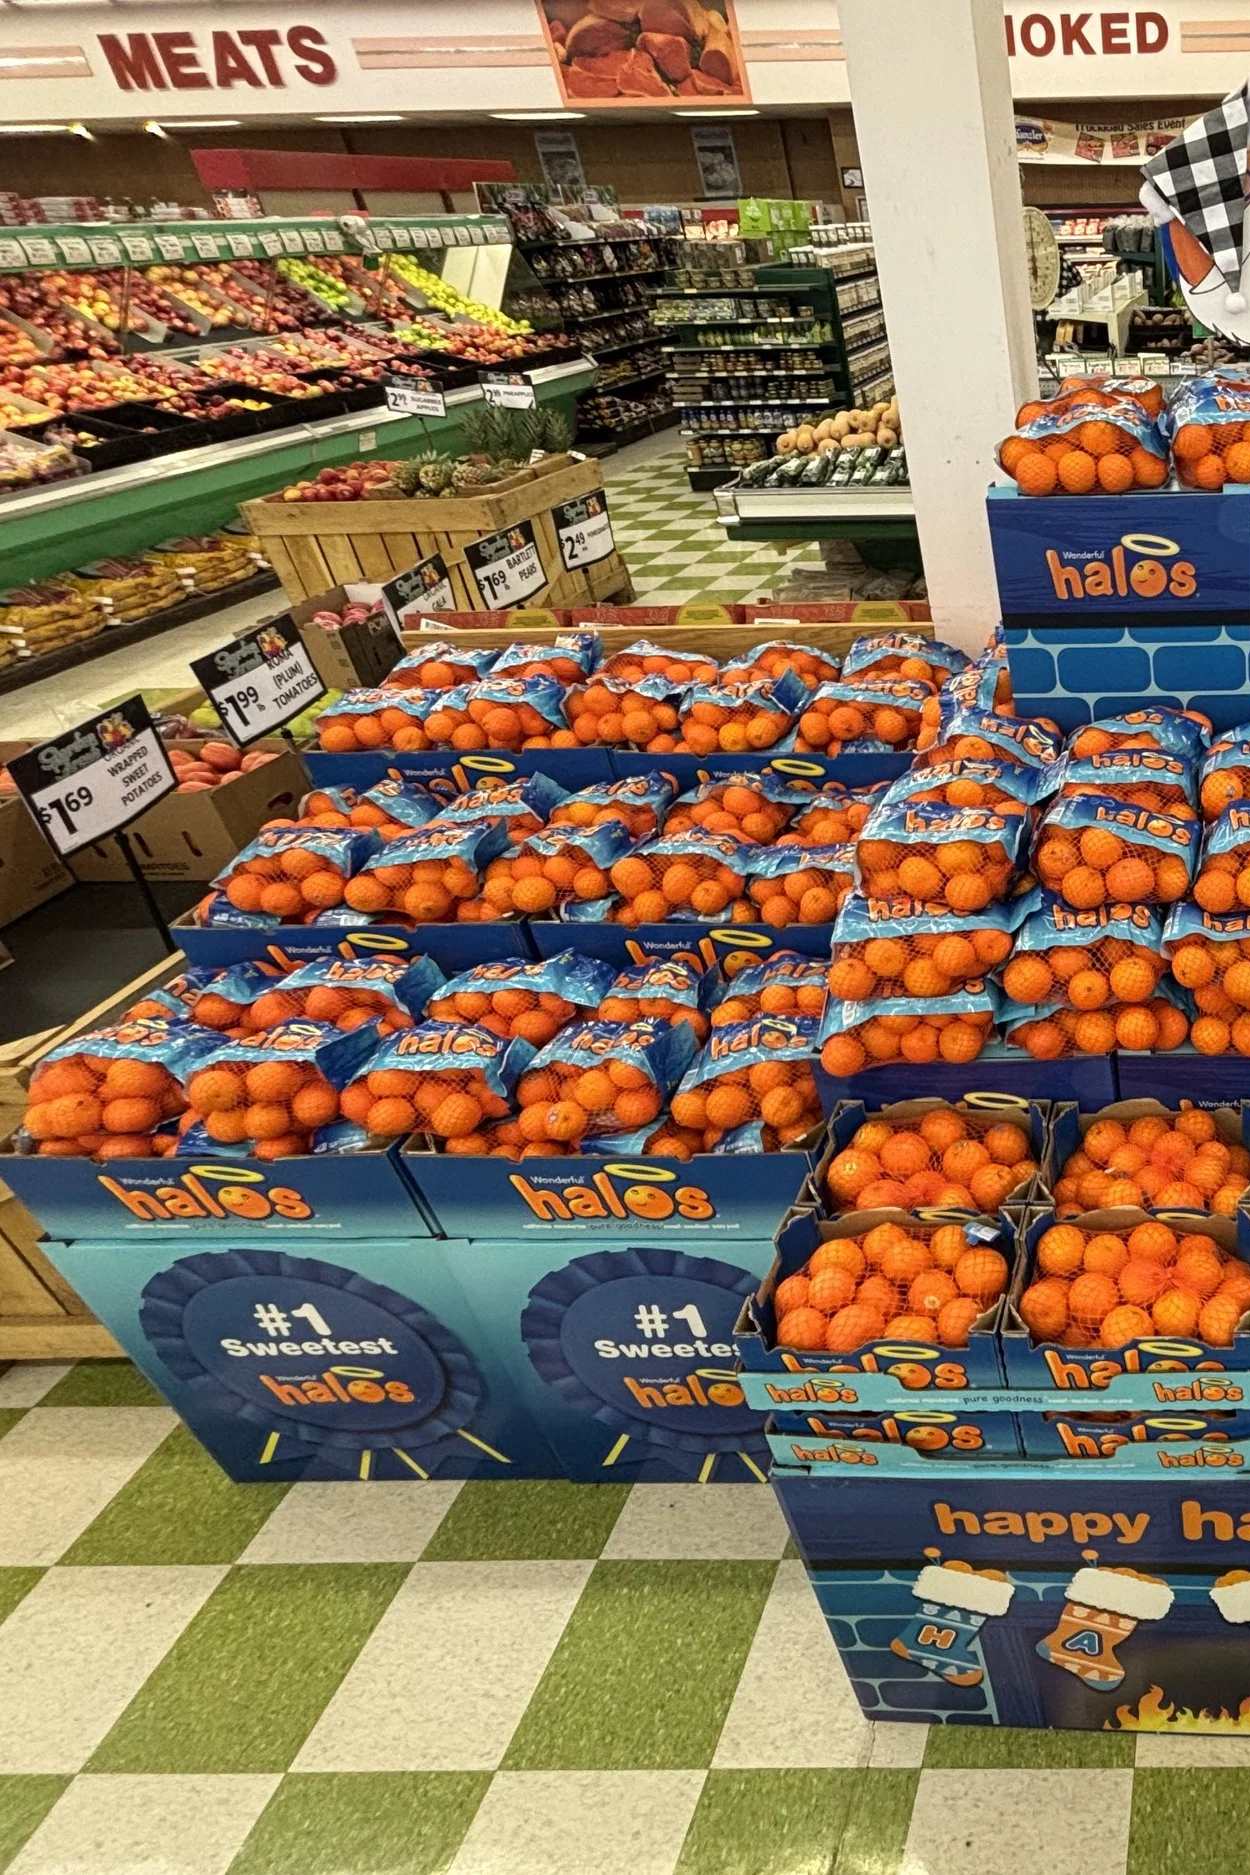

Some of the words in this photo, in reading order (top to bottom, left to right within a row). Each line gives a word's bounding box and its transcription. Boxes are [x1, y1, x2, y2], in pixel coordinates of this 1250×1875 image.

[1005, 12, 1169, 57] OKED
[97, 25, 338, 91] MEATS
[506, 545, 538, 570] BARTLETT
[1063, 550, 1106, 560] Wonderful
[518, 562, 539, 583] PEARS
[1046, 545, 1197, 600] halos
[266, 648, 295, 671] ROMA
[272, 660, 305, 690] (PLUM)
[272, 673, 319, 710] TOMATOES
[107, 746, 150, 778] WRAPPED
[404, 767, 446, 778] Wonderful
[1091, 753, 1185, 776] halos
[121, 771, 164, 807] POTATOES
[122, 763, 151, 789] SWEET
[38, 786, 94, 836] $169
[1096, 807, 1192, 846] halos
[1053, 902, 1152, 931] halos
[643, 940, 692, 950] Wonderful
[397, 1027, 499, 1060] halos
[530, 1175, 585, 1185] Wonderful
[97, 1173, 314, 1220] halos
[509, 1171, 715, 1221] halos
[254, 1303, 332, 1337] #1
[634, 1304, 708, 1339] #1
[220, 1337, 399, 1357] Sweetest
[594, 1339, 741, 1359] Sweete
[1066, 1353, 1106, 1361] Wonderful
[803, 1357, 843, 1365] Wonderful
[259, 1371, 416, 1406] halos
[623, 1374, 746, 1409] halo
[765, 1379, 859, 1404] halos
[963, 1395, 989, 1405] pure
[992, 1394, 1045, 1405] goodness
[1153, 1379, 1245, 1403] halos
[791, 1444, 879, 1466] halos
[1158, 1449, 1245, 1468] halos
[933, 1502, 1150, 1544] happy
